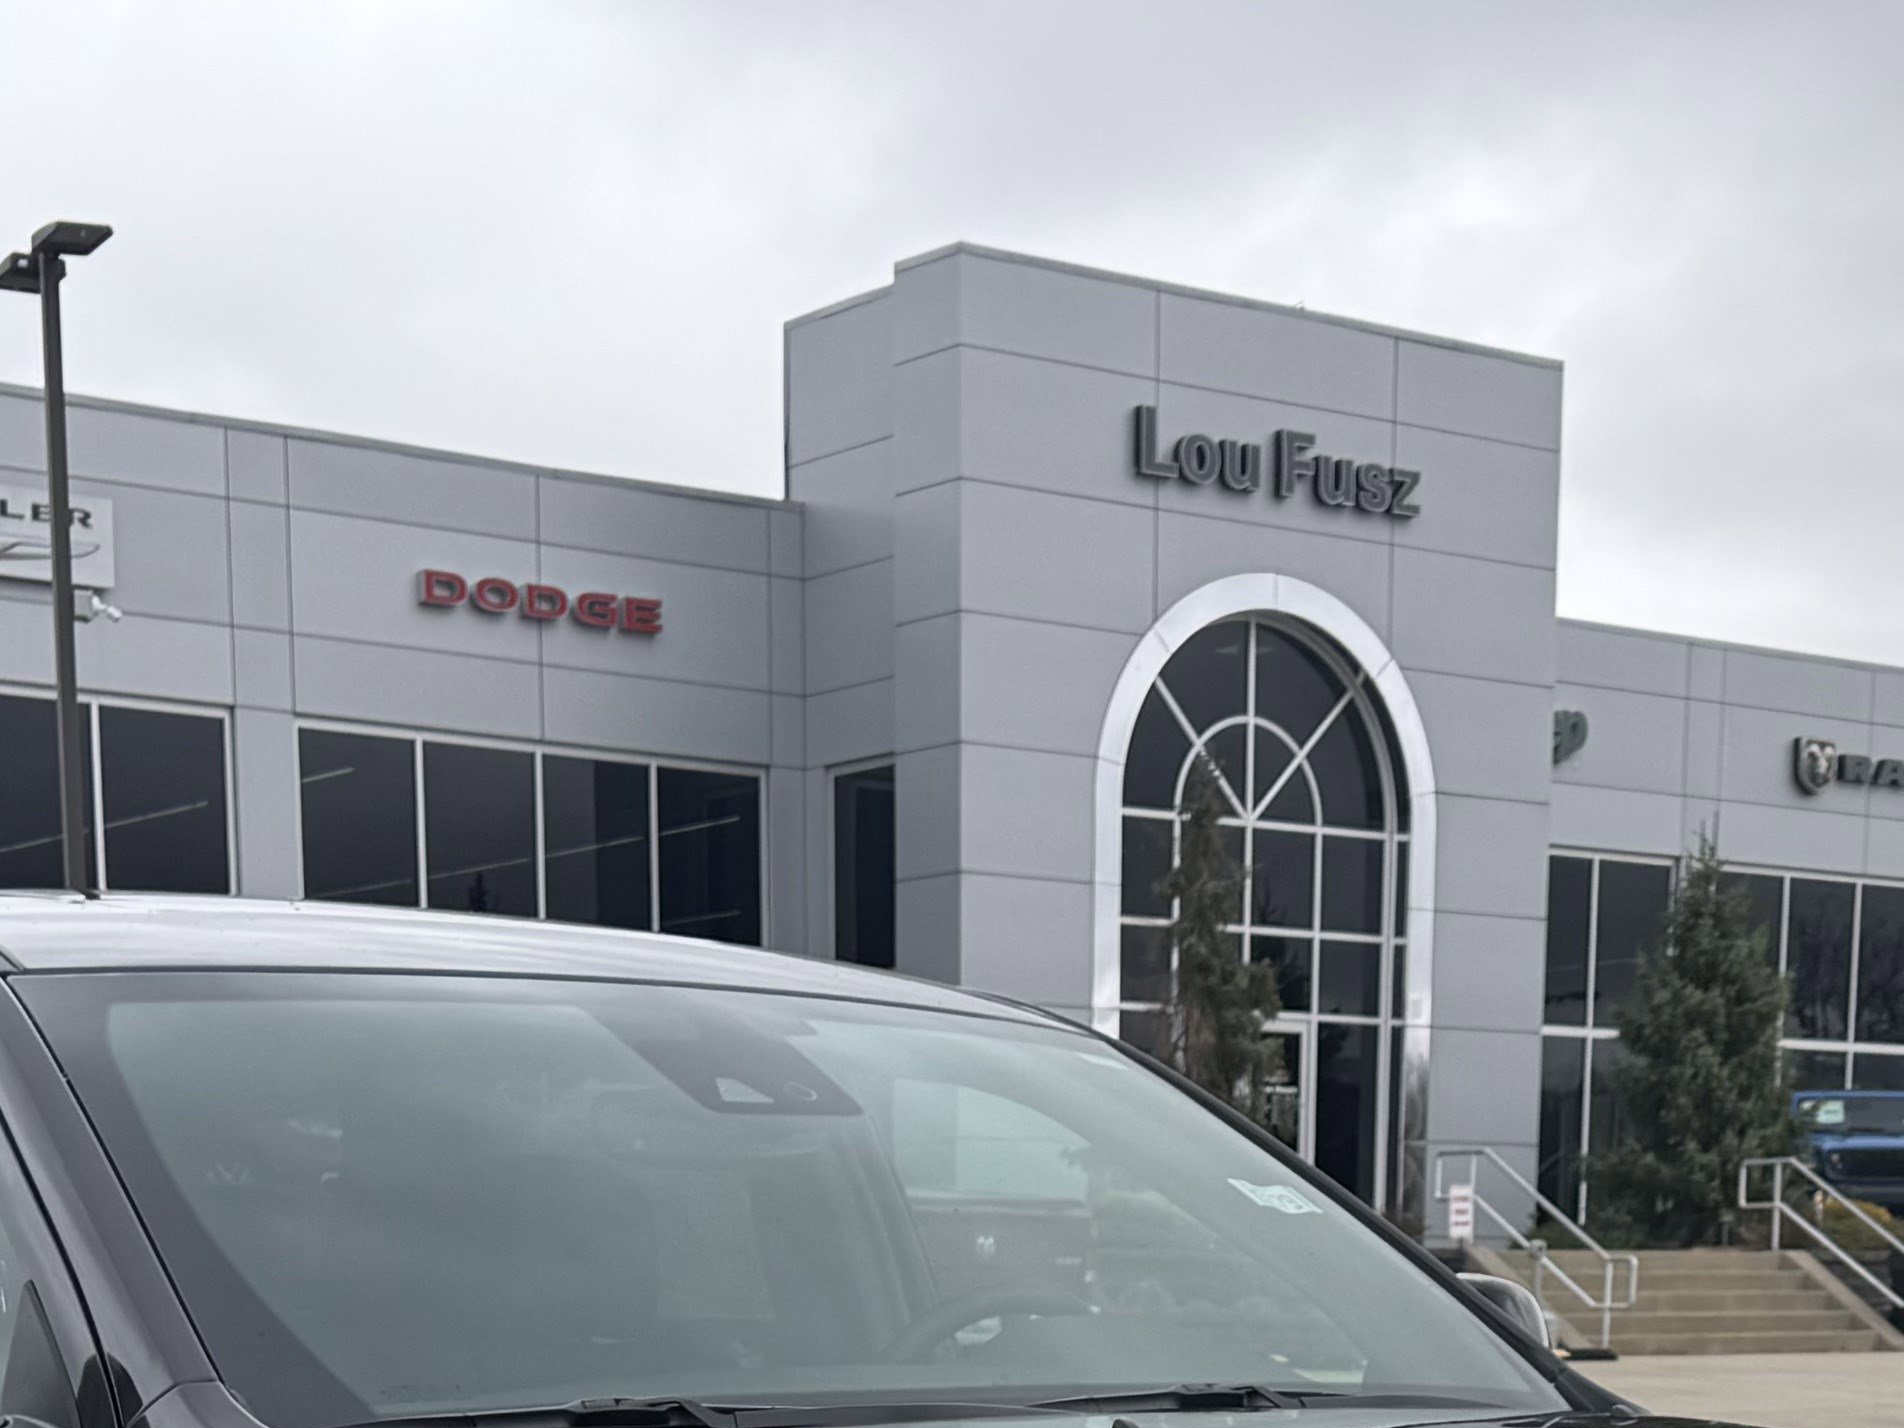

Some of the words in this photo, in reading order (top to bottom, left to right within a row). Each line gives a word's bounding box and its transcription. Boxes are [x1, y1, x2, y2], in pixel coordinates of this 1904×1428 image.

[1134, 404, 1261, 493] Lou
[1274, 428, 1421, 517] Fusz
[416, 568, 664, 633] DODGE
